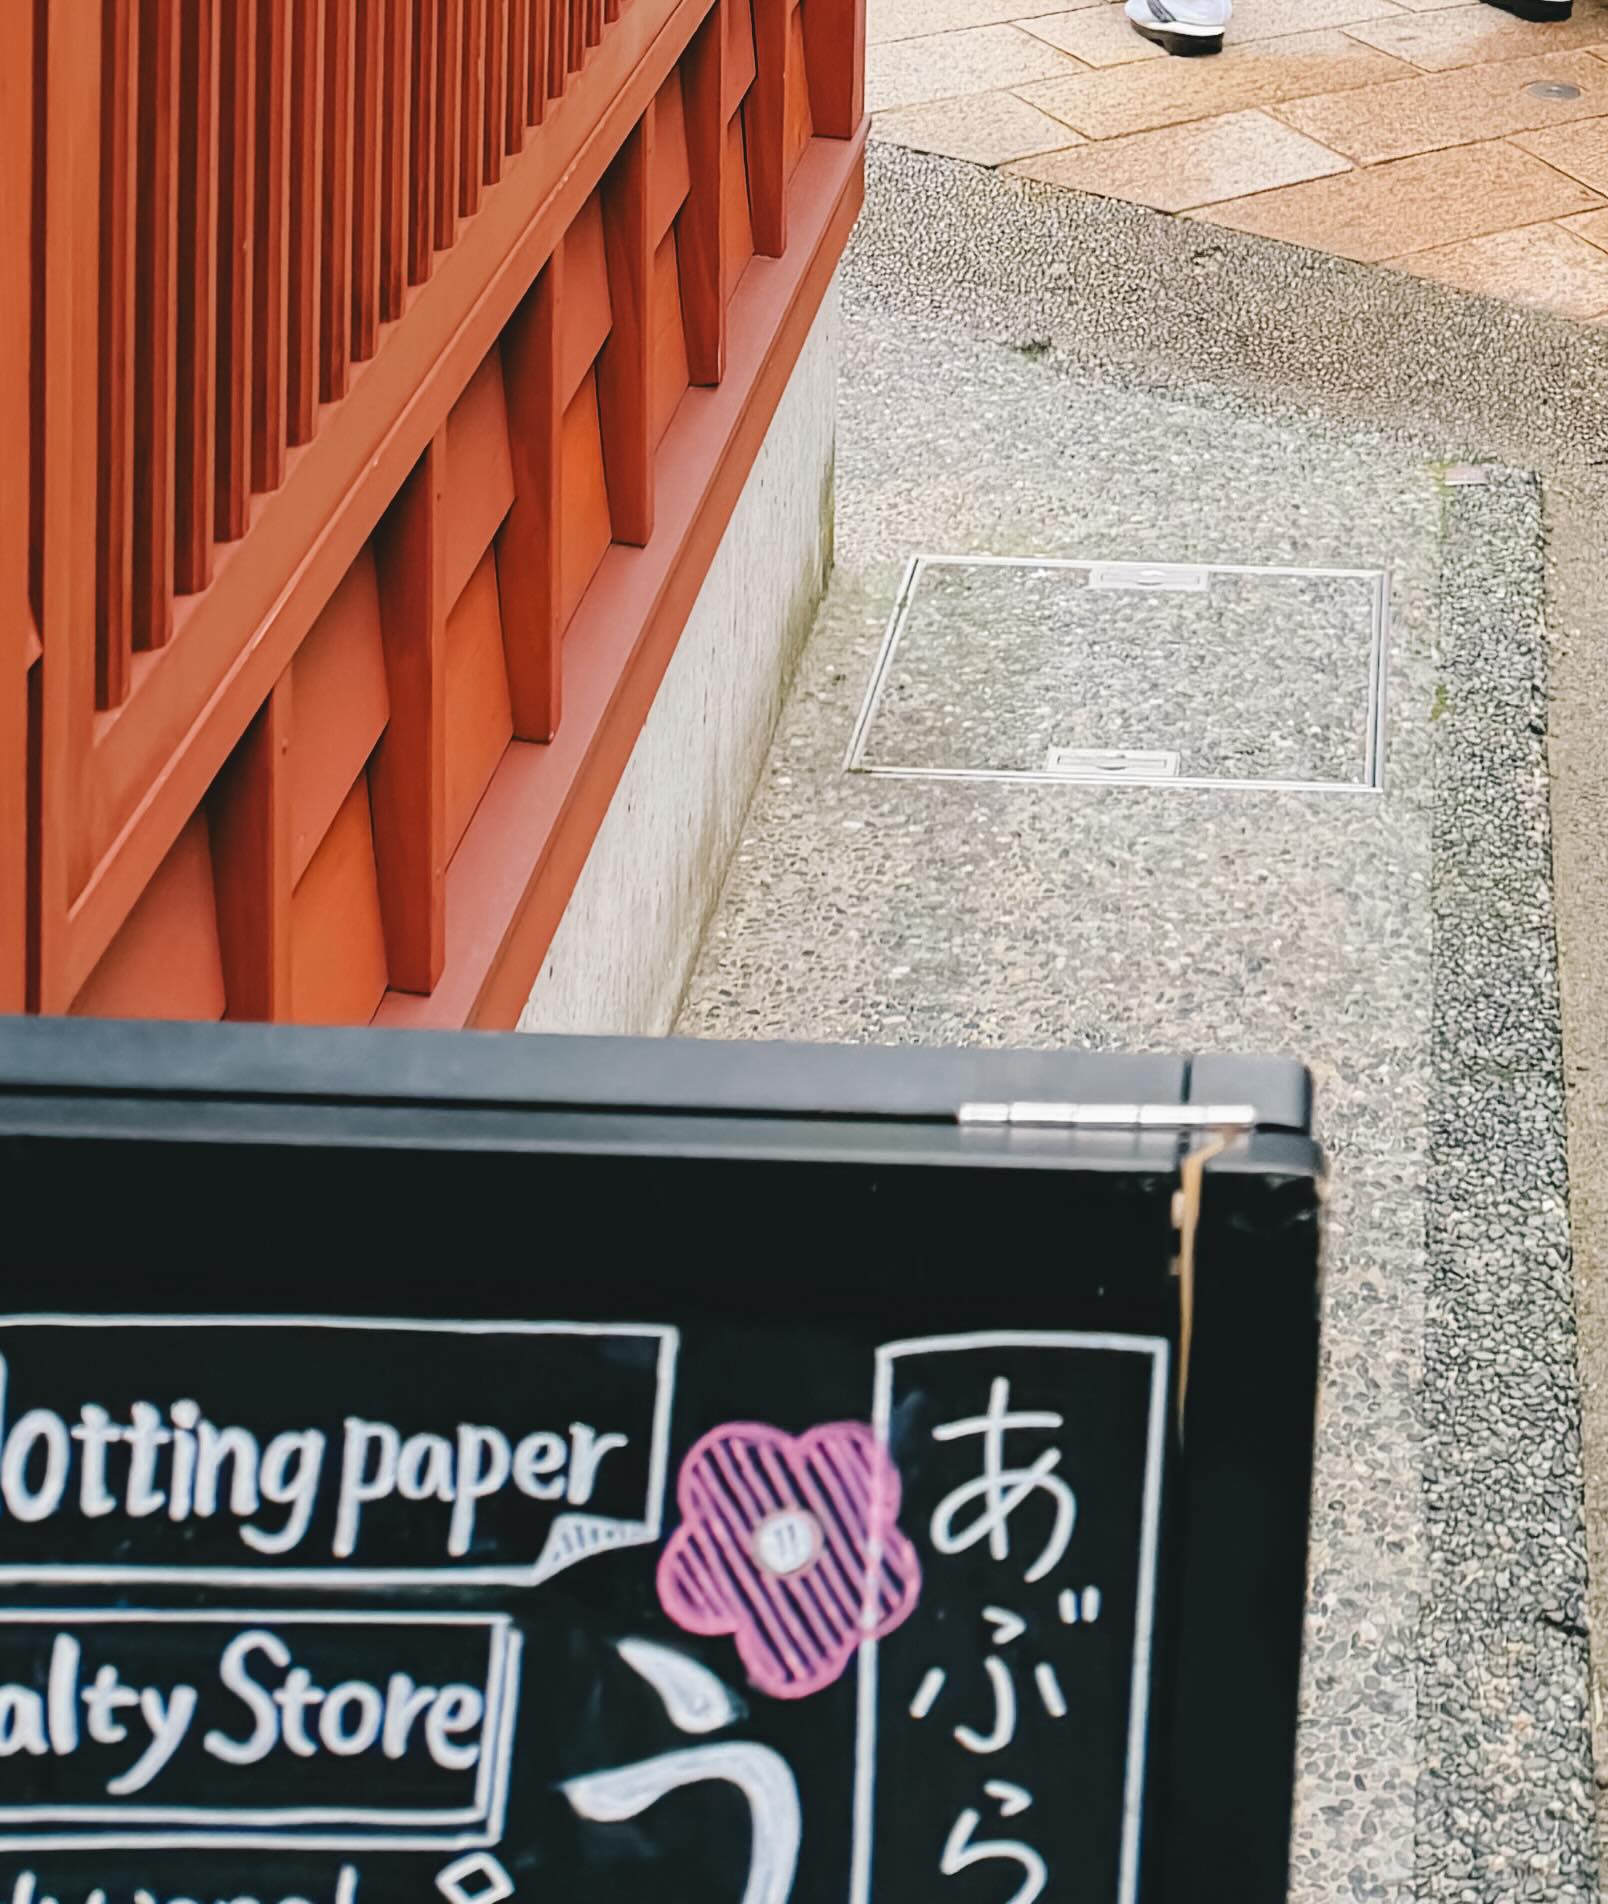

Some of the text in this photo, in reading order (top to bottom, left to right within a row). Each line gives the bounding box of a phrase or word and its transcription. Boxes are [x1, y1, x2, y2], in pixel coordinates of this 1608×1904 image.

[0, 1353, 628, 1558] otting paper
[0, 1629, 485, 1795] alty Store
[911, 1376, 1100, 1904] あぶら
